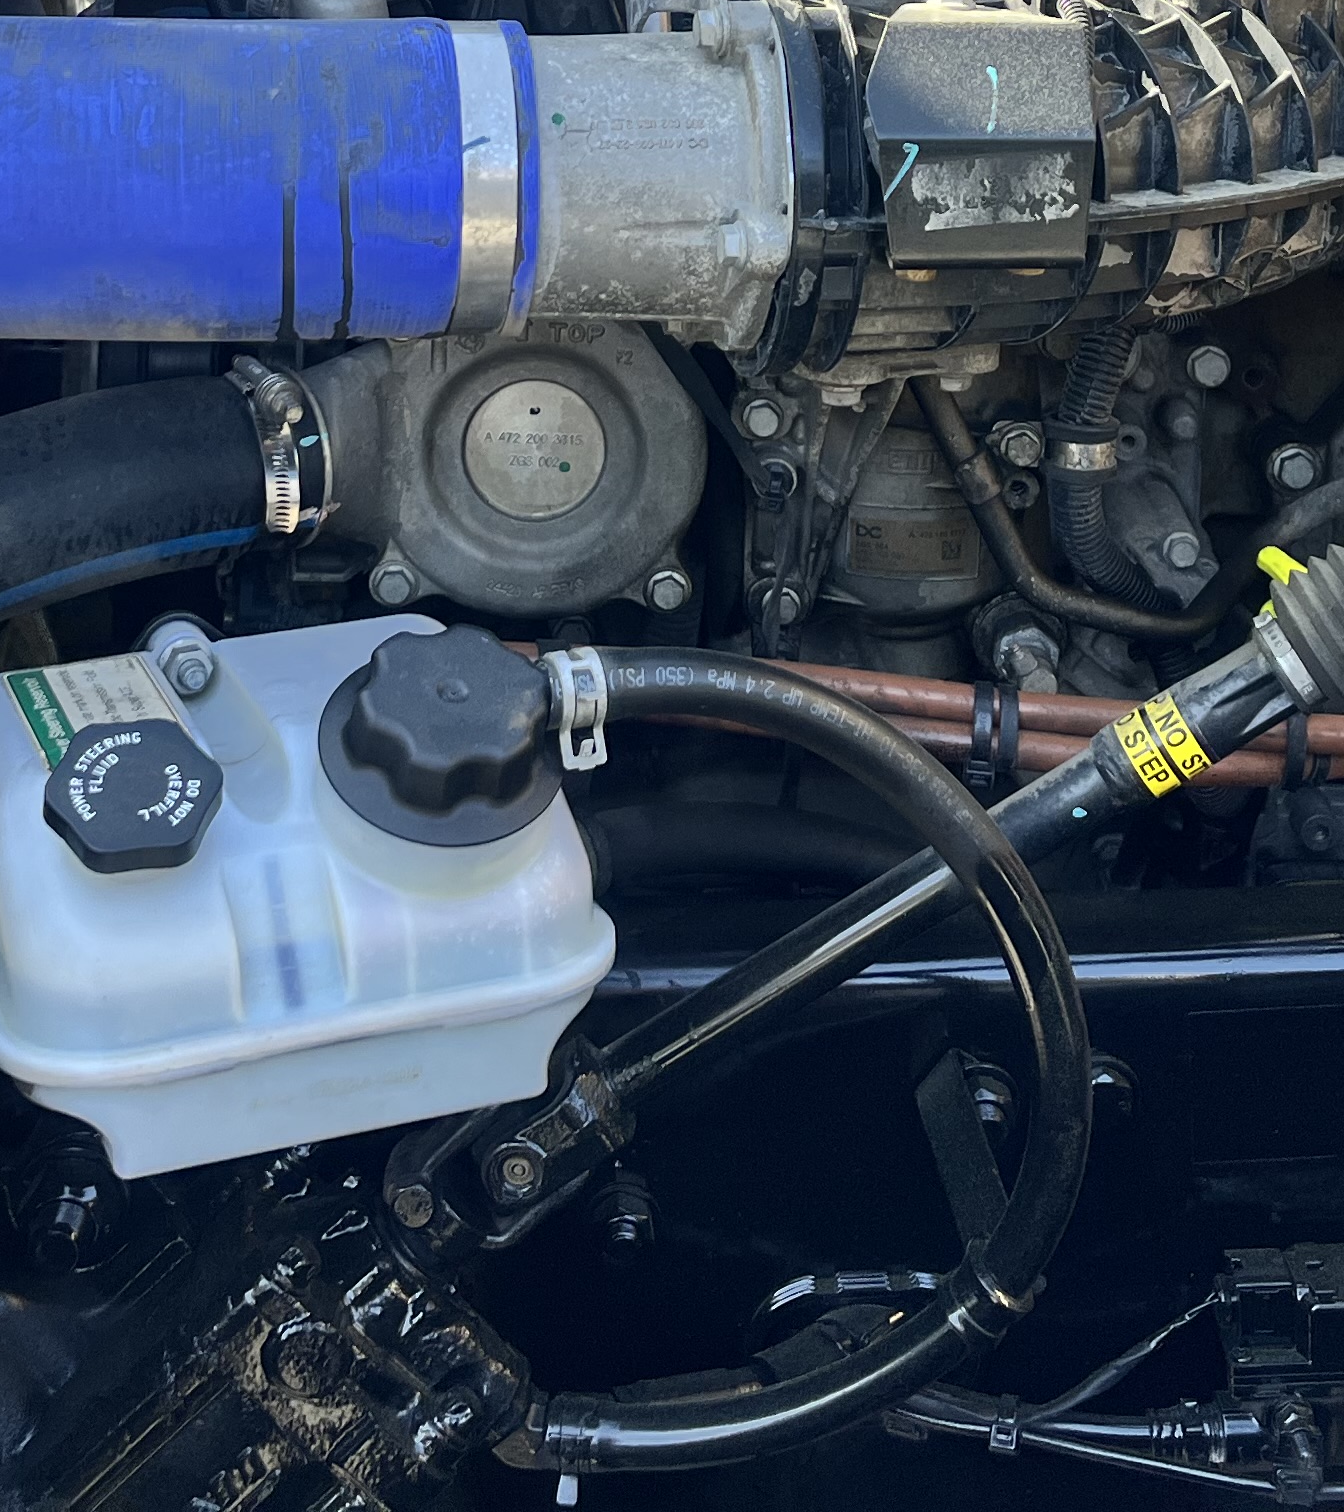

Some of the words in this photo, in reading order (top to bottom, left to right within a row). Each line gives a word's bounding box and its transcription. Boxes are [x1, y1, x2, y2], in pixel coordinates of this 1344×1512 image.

[548, 321, 606, 344] TOP
[484, 432, 494, 444] A
[498, 432, 520, 445] 472
[609, 666, 646, 692] PSI)
[655, 666, 695, 687] (350
[707, 667, 737, 691] MPa
[746, 674, 776, 699] 2.4
[1154, 709, 1188, 748] NO
[73, 731, 142, 773] STEERING
[1123, 729, 1171, 783] STEP
[88, 752, 120, 795] FLUID
[68, 776, 97, 822] POWER
[136, 763, 183, 822] OVERFILL
[185, 778, 201, 799] DO
[167, 799, 195, 827] NOT
